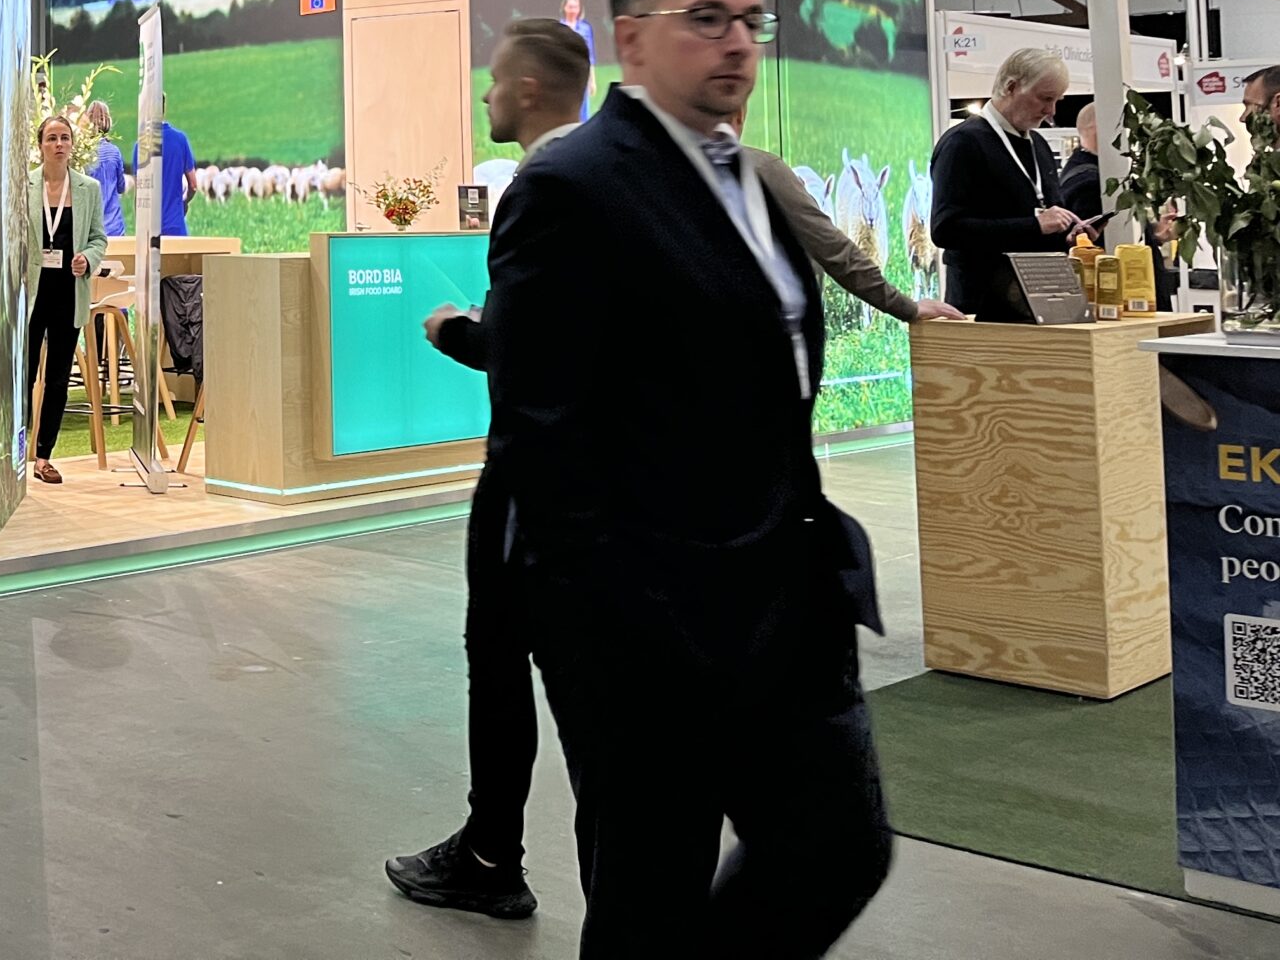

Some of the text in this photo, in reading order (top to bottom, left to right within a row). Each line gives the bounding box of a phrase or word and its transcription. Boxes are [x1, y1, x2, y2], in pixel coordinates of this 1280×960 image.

[954, 38, 976, 47] K:21
[348, 269, 402, 285] BORD BIA
[366, 287, 382, 296] FOOD
[383, 286, 403, 295] BOARD
[1220, 556, 1280, 584] peo
